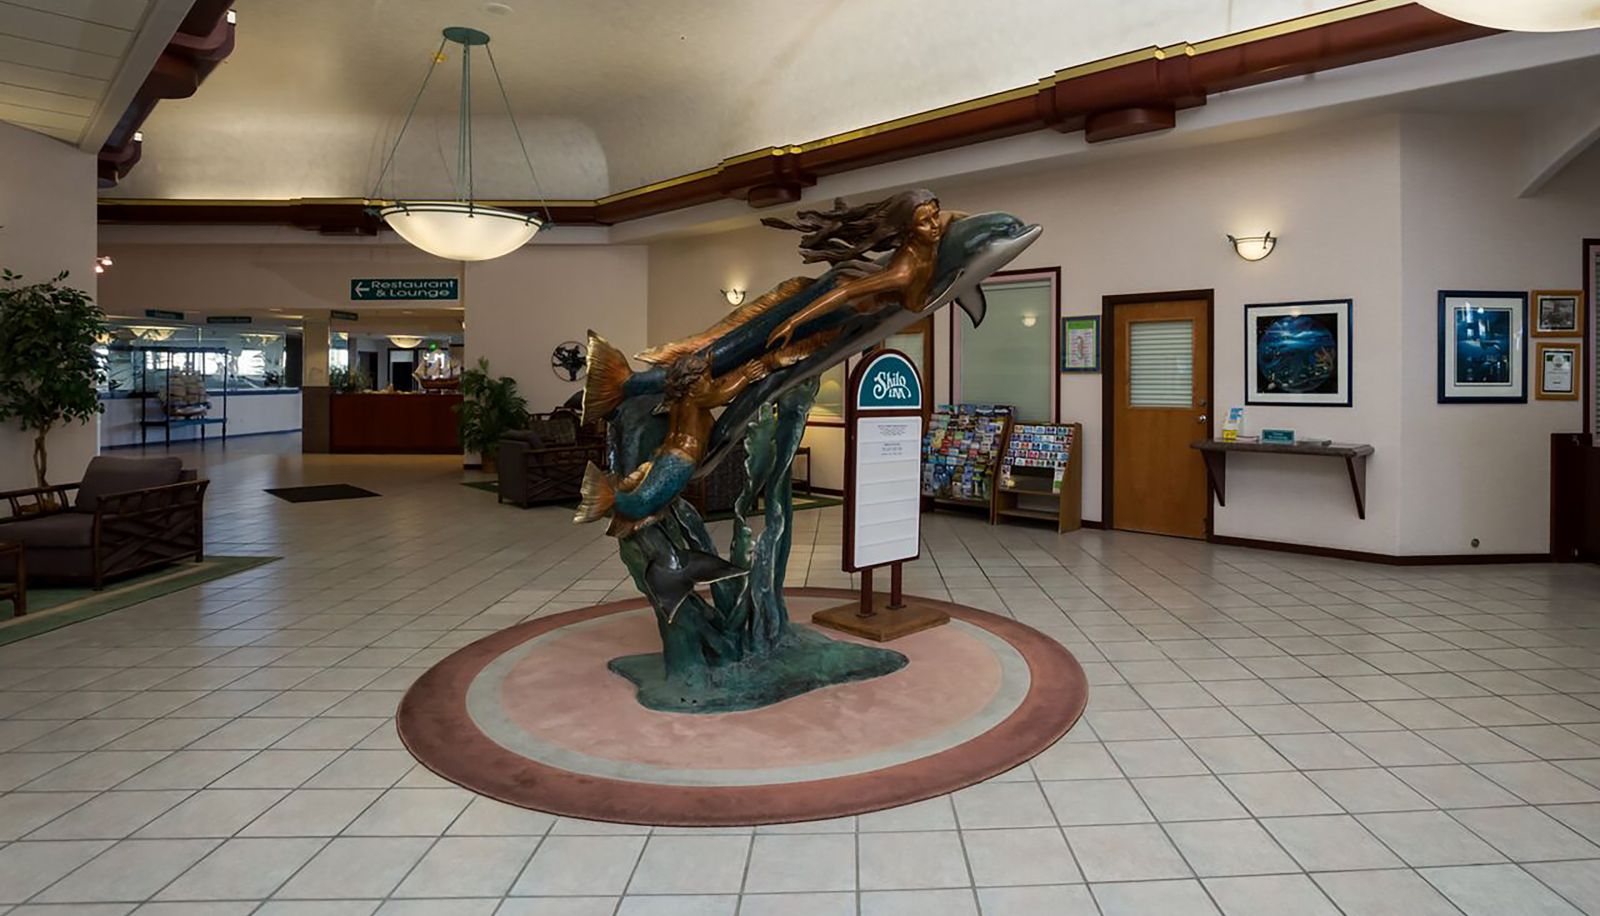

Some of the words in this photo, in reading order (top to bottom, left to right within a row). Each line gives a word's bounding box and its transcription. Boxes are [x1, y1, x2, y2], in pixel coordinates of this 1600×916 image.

[371, 280, 454, 289] Restaurant
[376, 289, 385, 298] &
[389, 289, 450, 298] Lounge
[873, 371, 911, 399] Shilo
